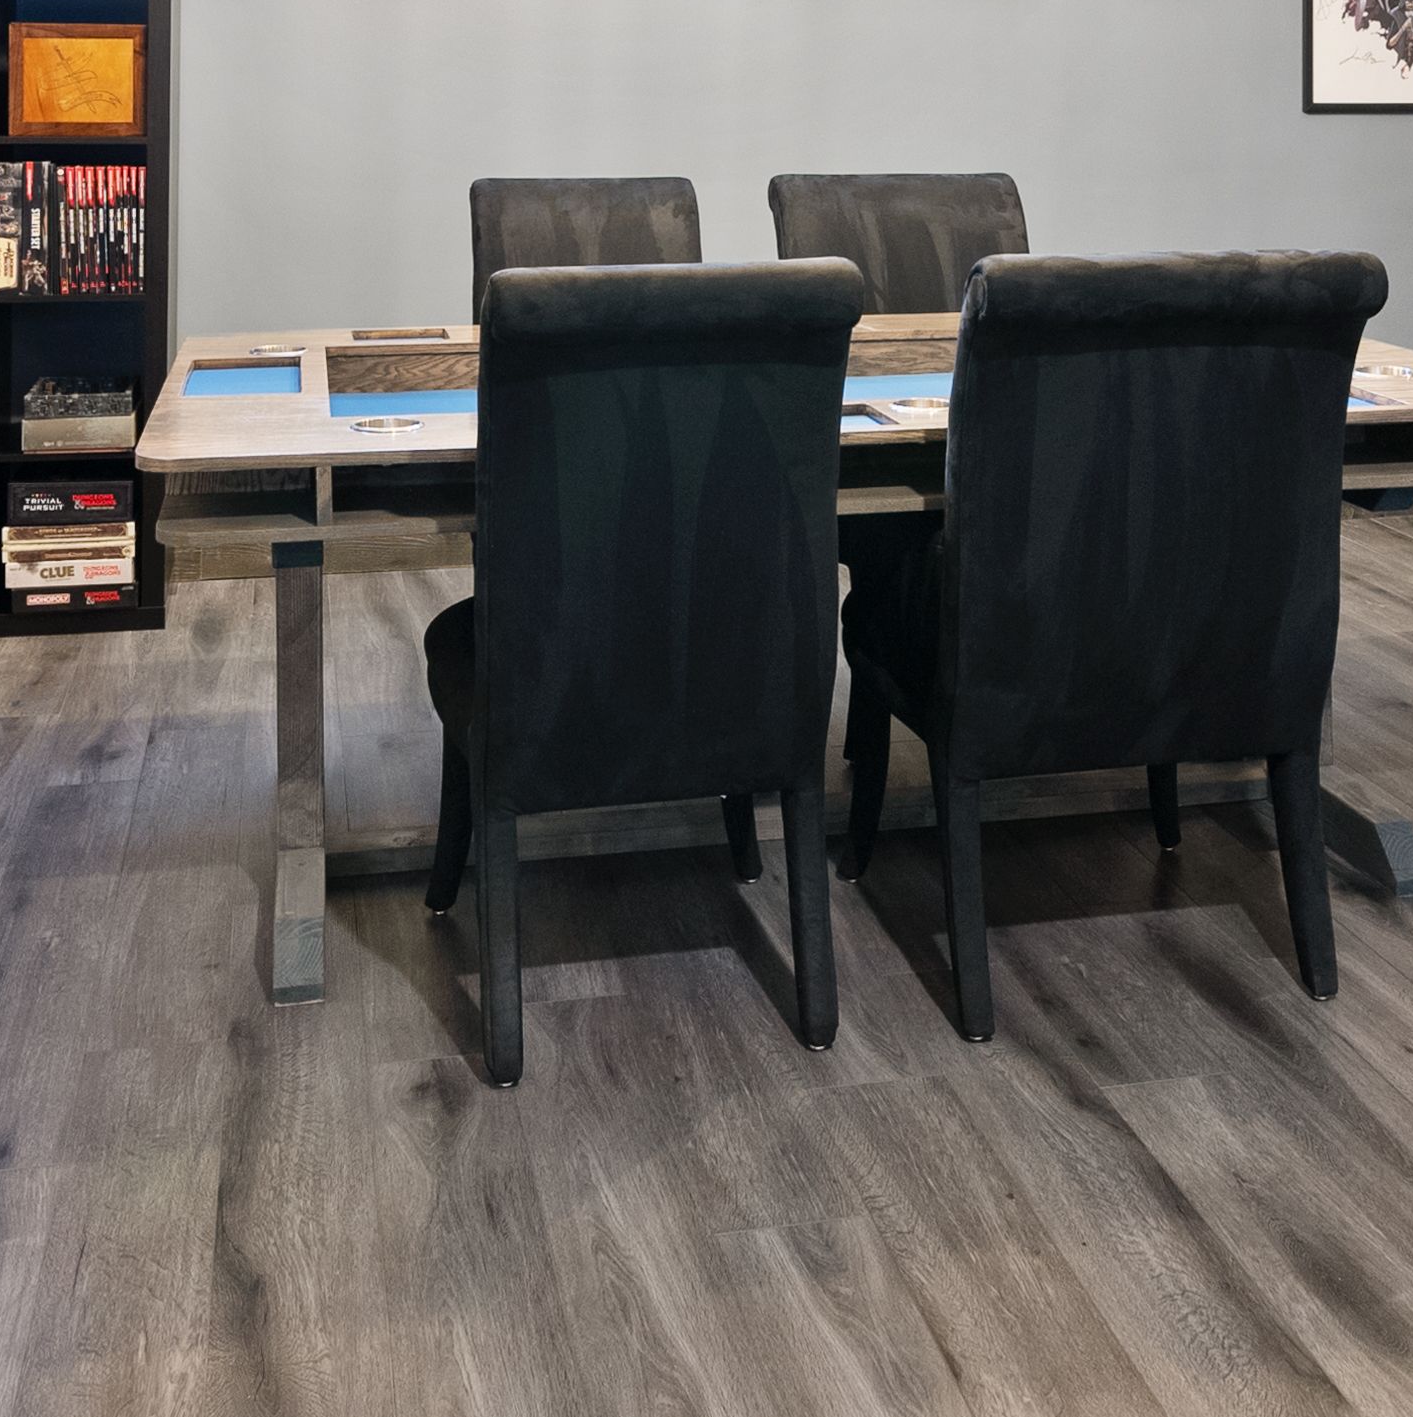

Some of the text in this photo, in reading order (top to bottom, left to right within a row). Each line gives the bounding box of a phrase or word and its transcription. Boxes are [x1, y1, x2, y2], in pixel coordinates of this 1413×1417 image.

[31, 207, 41, 250] STARTER SET
[40, 566, 75, 579] CLUE
[28, 595, 69, 604] MONOPOLY
